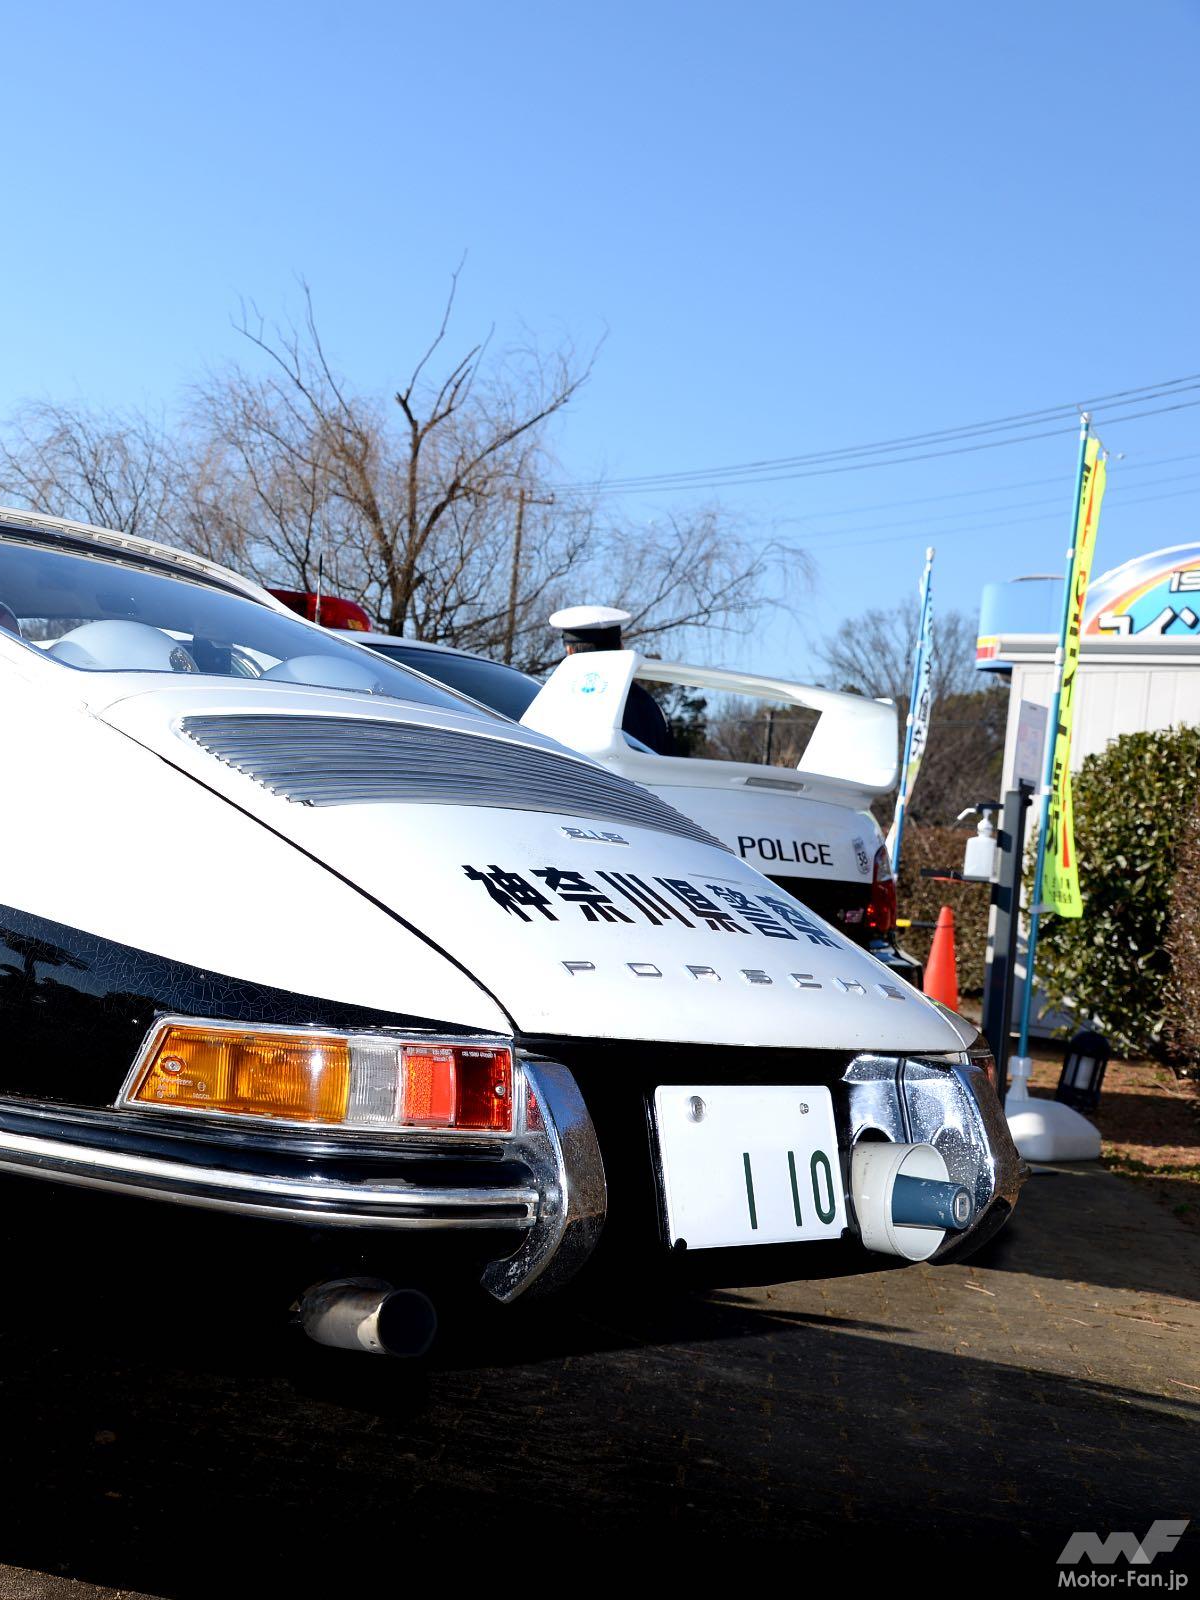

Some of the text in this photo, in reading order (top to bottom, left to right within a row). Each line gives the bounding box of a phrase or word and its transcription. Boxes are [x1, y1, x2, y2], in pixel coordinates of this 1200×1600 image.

[738, 836, 833, 866] POLICE
[461, 864, 845, 951] 神奈川県警察
[560, 960, 906, 1001] PORSCHE
